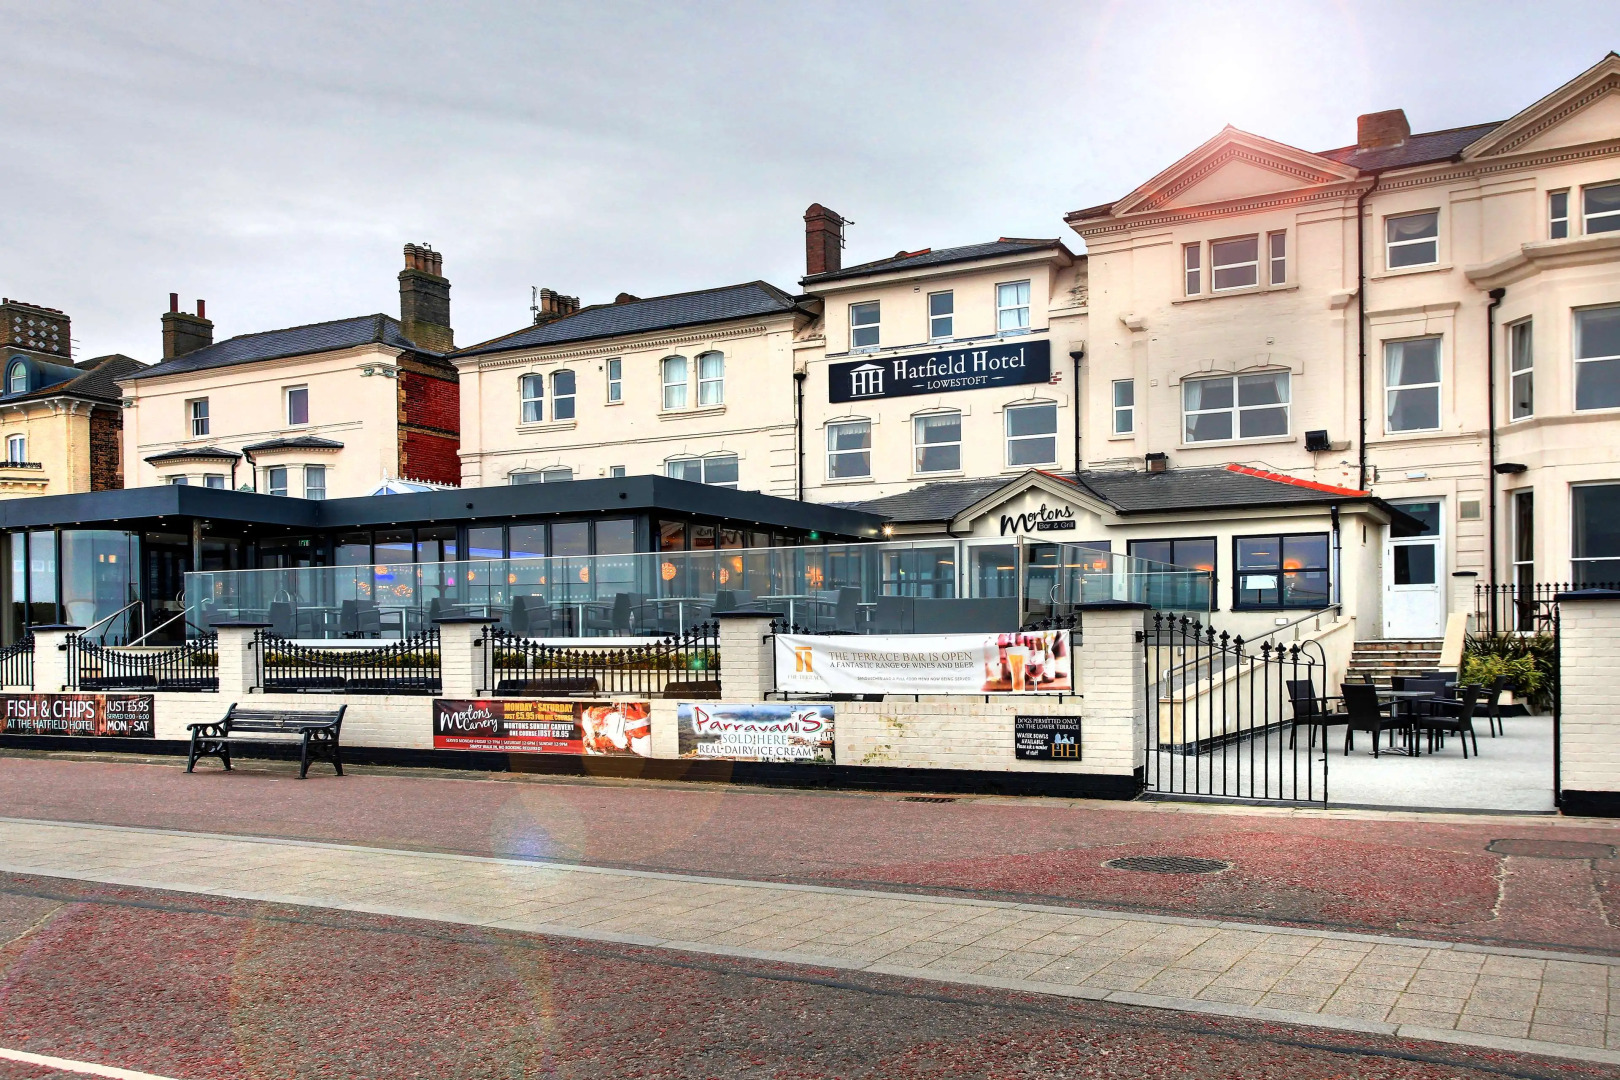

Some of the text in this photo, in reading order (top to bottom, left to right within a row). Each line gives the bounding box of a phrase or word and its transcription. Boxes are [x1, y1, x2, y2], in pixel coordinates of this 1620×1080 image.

[893, 347, 1026, 381] Hatfield Hotel
[927, 375, 988, 390] LOWESTOFT
[1000, 503, 1074, 536] Mortons
[1038, 522, 1051, 530] Bar
[1060, 521, 1074, 529] Grill
[829, 651, 973, 662] THE TERRACE BAR IS OPEN
[836, 661, 874, 669] FANTASTIC
[875, 661, 900, 669] RANGE
[900, 661, 911, 669] OF
[912, 661, 936, 669] WINES
[937, 661, 953, 669] AND
[954, 661, 975, 669] BEER
[7, 699, 96, 719] FISH & CHIPS
[107, 700, 149, 713] JUST £5.95
[503, 702, 533, 712] MONDAY
[537, 703, 574, 713] SATURDAY
[440, 704, 493, 732] Mortons
[515, 711, 535, 720] £5.95
[7, 719, 95, 731] AT THE HATFIELD HOTEL
[107, 720, 127, 731] MON
[133, 721, 149, 732] SAT
[463, 717, 498, 733] Carvery
[529, 722, 550, 730] SUNDAY
[550, 723, 574, 731] CARVERY
[551, 730, 570, 738] £8.95
[722, 734, 787, 746] SOLD HERE
[699, 744, 812, 757] REAL DAIRY ICE CREAM
